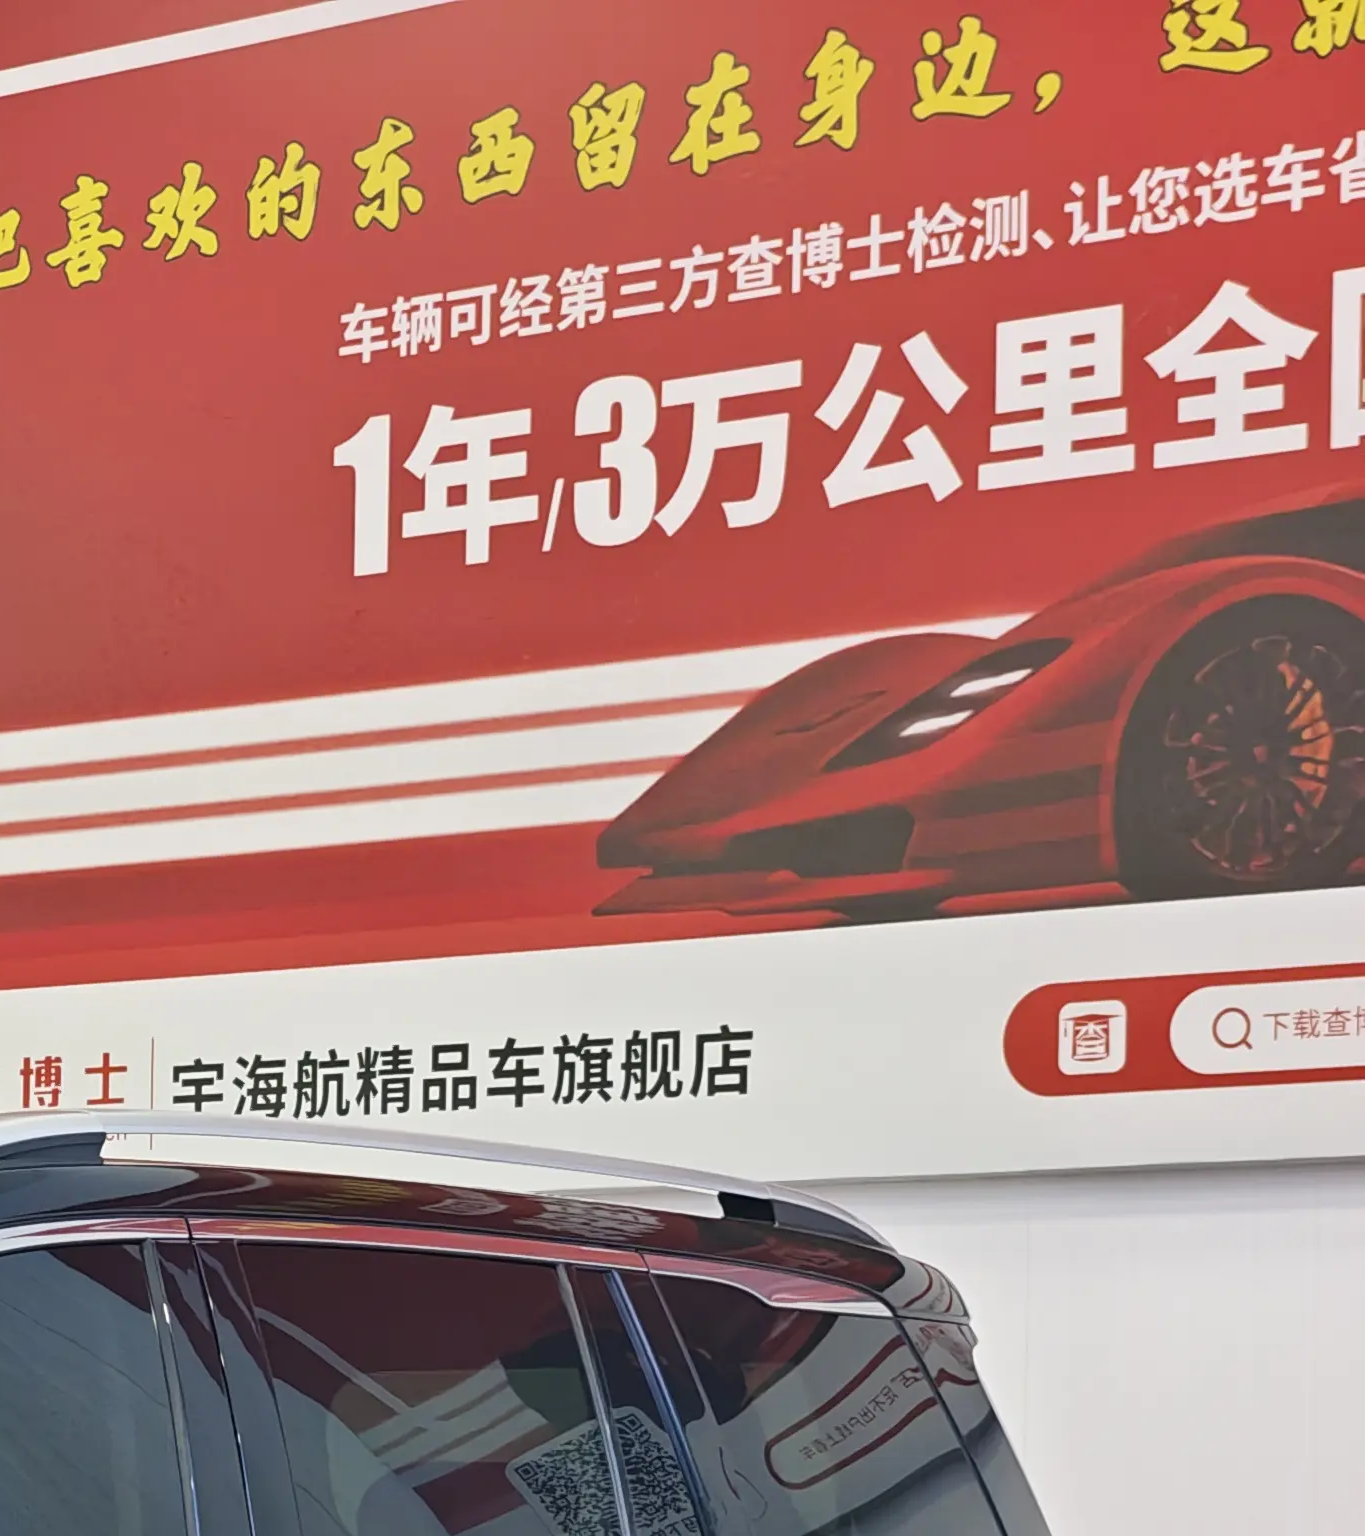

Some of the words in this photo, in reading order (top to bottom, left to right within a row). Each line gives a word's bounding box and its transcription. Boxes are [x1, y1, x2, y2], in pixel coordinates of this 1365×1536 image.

[333, 267, 1365, 577] 1年/3万公里全
[171, 1025, 755, 1120] 宇海航精品车旗舰店
